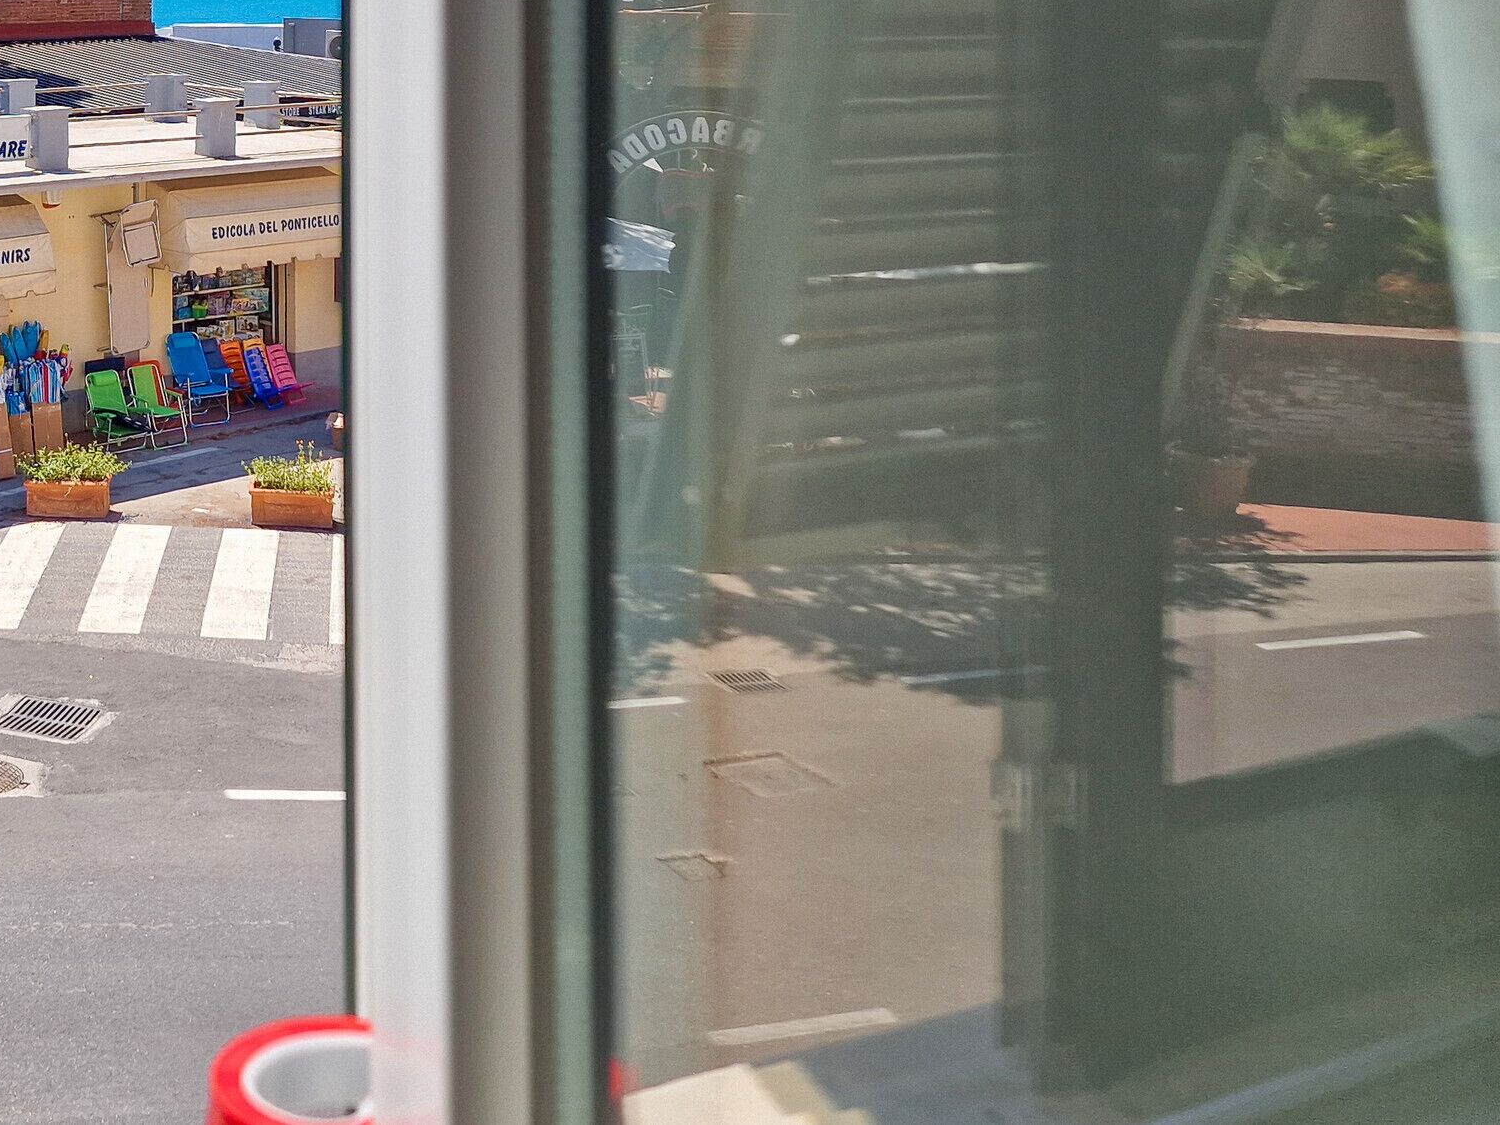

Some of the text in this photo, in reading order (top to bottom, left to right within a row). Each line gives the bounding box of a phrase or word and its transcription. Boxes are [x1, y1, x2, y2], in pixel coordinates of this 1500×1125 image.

[211, 214, 340, 240] EDICOLA DEL PONTICELLO
